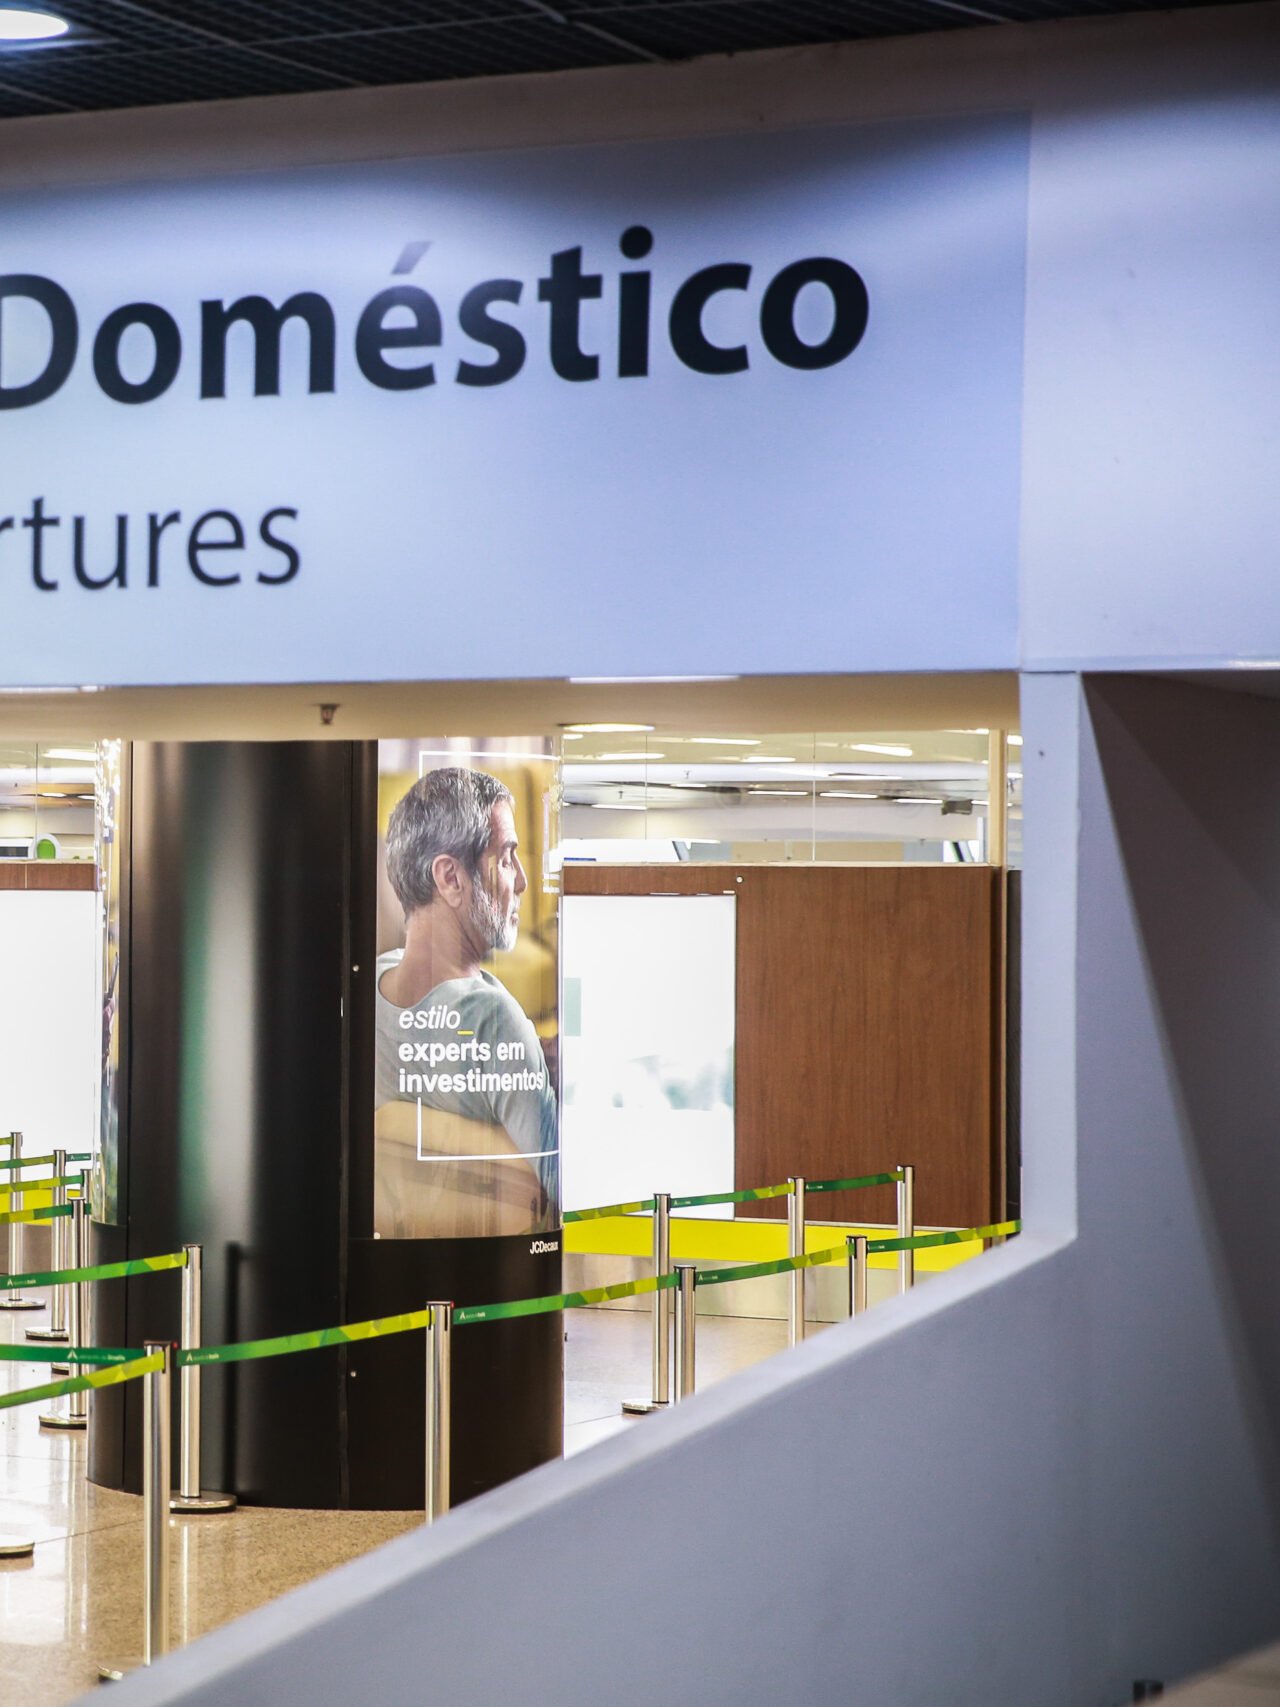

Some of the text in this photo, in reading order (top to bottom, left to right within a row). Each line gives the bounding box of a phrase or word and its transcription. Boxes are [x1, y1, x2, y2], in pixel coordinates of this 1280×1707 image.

[398, 1037, 525, 1067] experts em
[398, 1068, 544, 1093] investimentos
